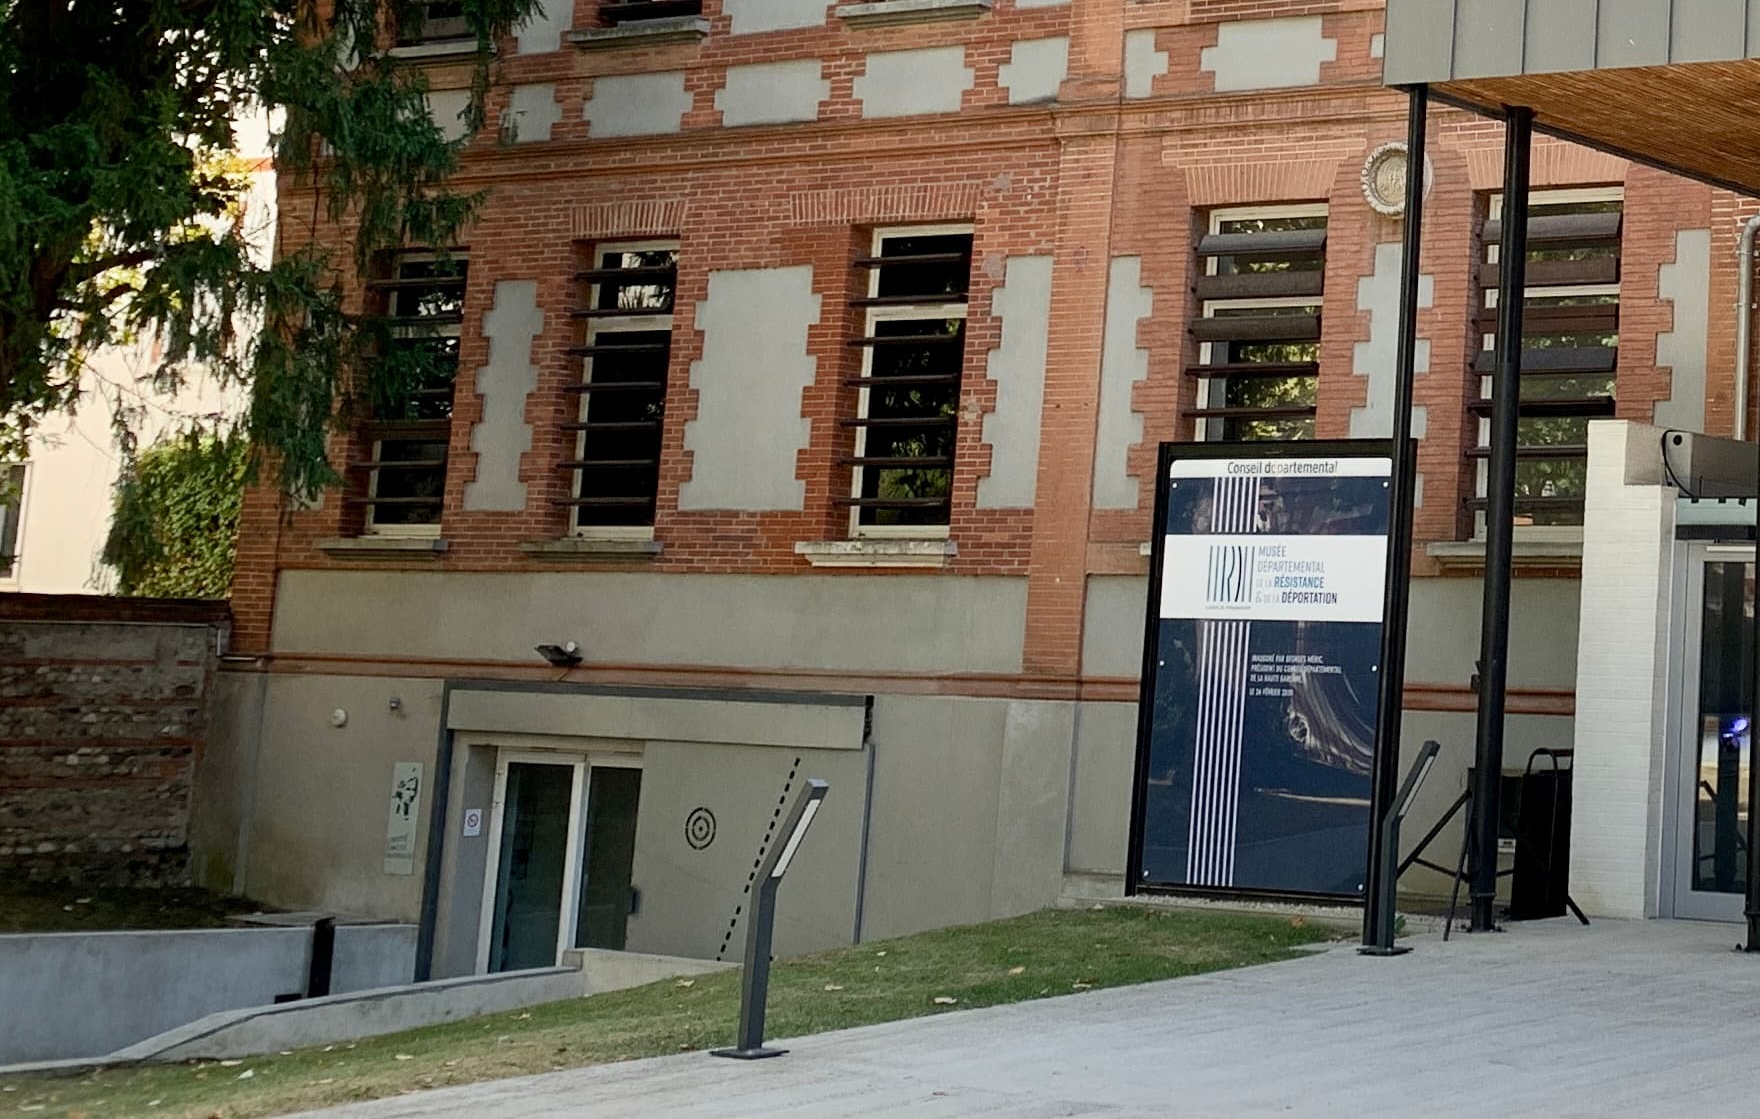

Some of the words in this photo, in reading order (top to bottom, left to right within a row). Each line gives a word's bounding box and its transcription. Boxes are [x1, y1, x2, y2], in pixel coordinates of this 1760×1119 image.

[1227, 461, 1262, 474] Conseil
[1258, 543, 1288, 558] MUSÉE
[1257, 558, 1326, 574] DÉPARTEMENTAL
[1273, 573, 1325, 589] RÉSISTANCE
[1281, 590, 1338, 605] DÉPORTATION
